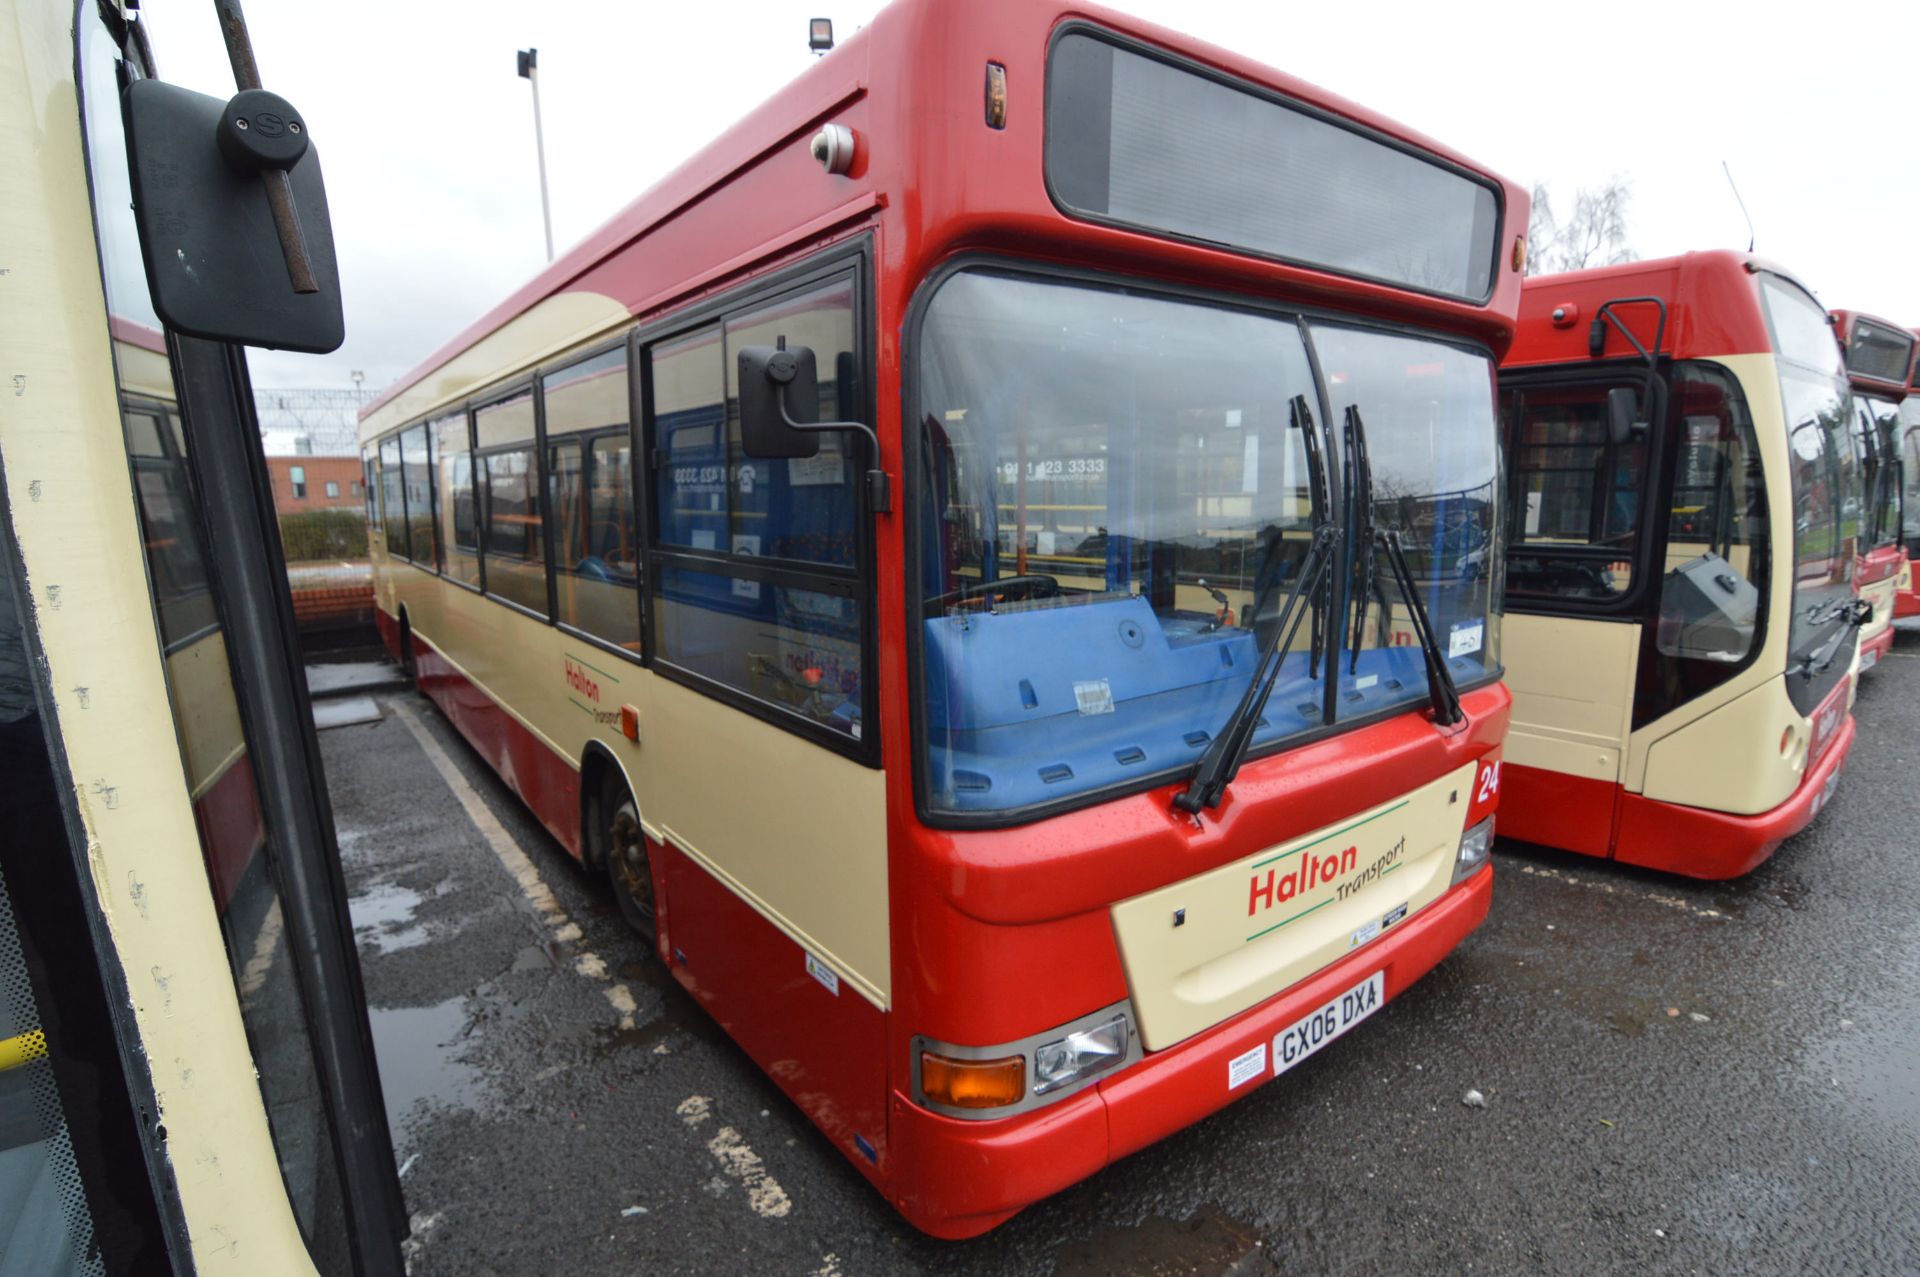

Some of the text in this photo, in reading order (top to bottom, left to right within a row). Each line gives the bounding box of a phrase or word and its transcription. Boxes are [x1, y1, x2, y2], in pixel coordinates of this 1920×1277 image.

[1068, 459, 1105, 474] 3333
[564, 659, 600, 704] Halton
[1477, 760, 1501, 803] 24
[1248, 845, 1357, 917] Halton
[1337, 835, 1405, 902] Transport
[1283, 981, 1376, 1064] GX06 DXA
